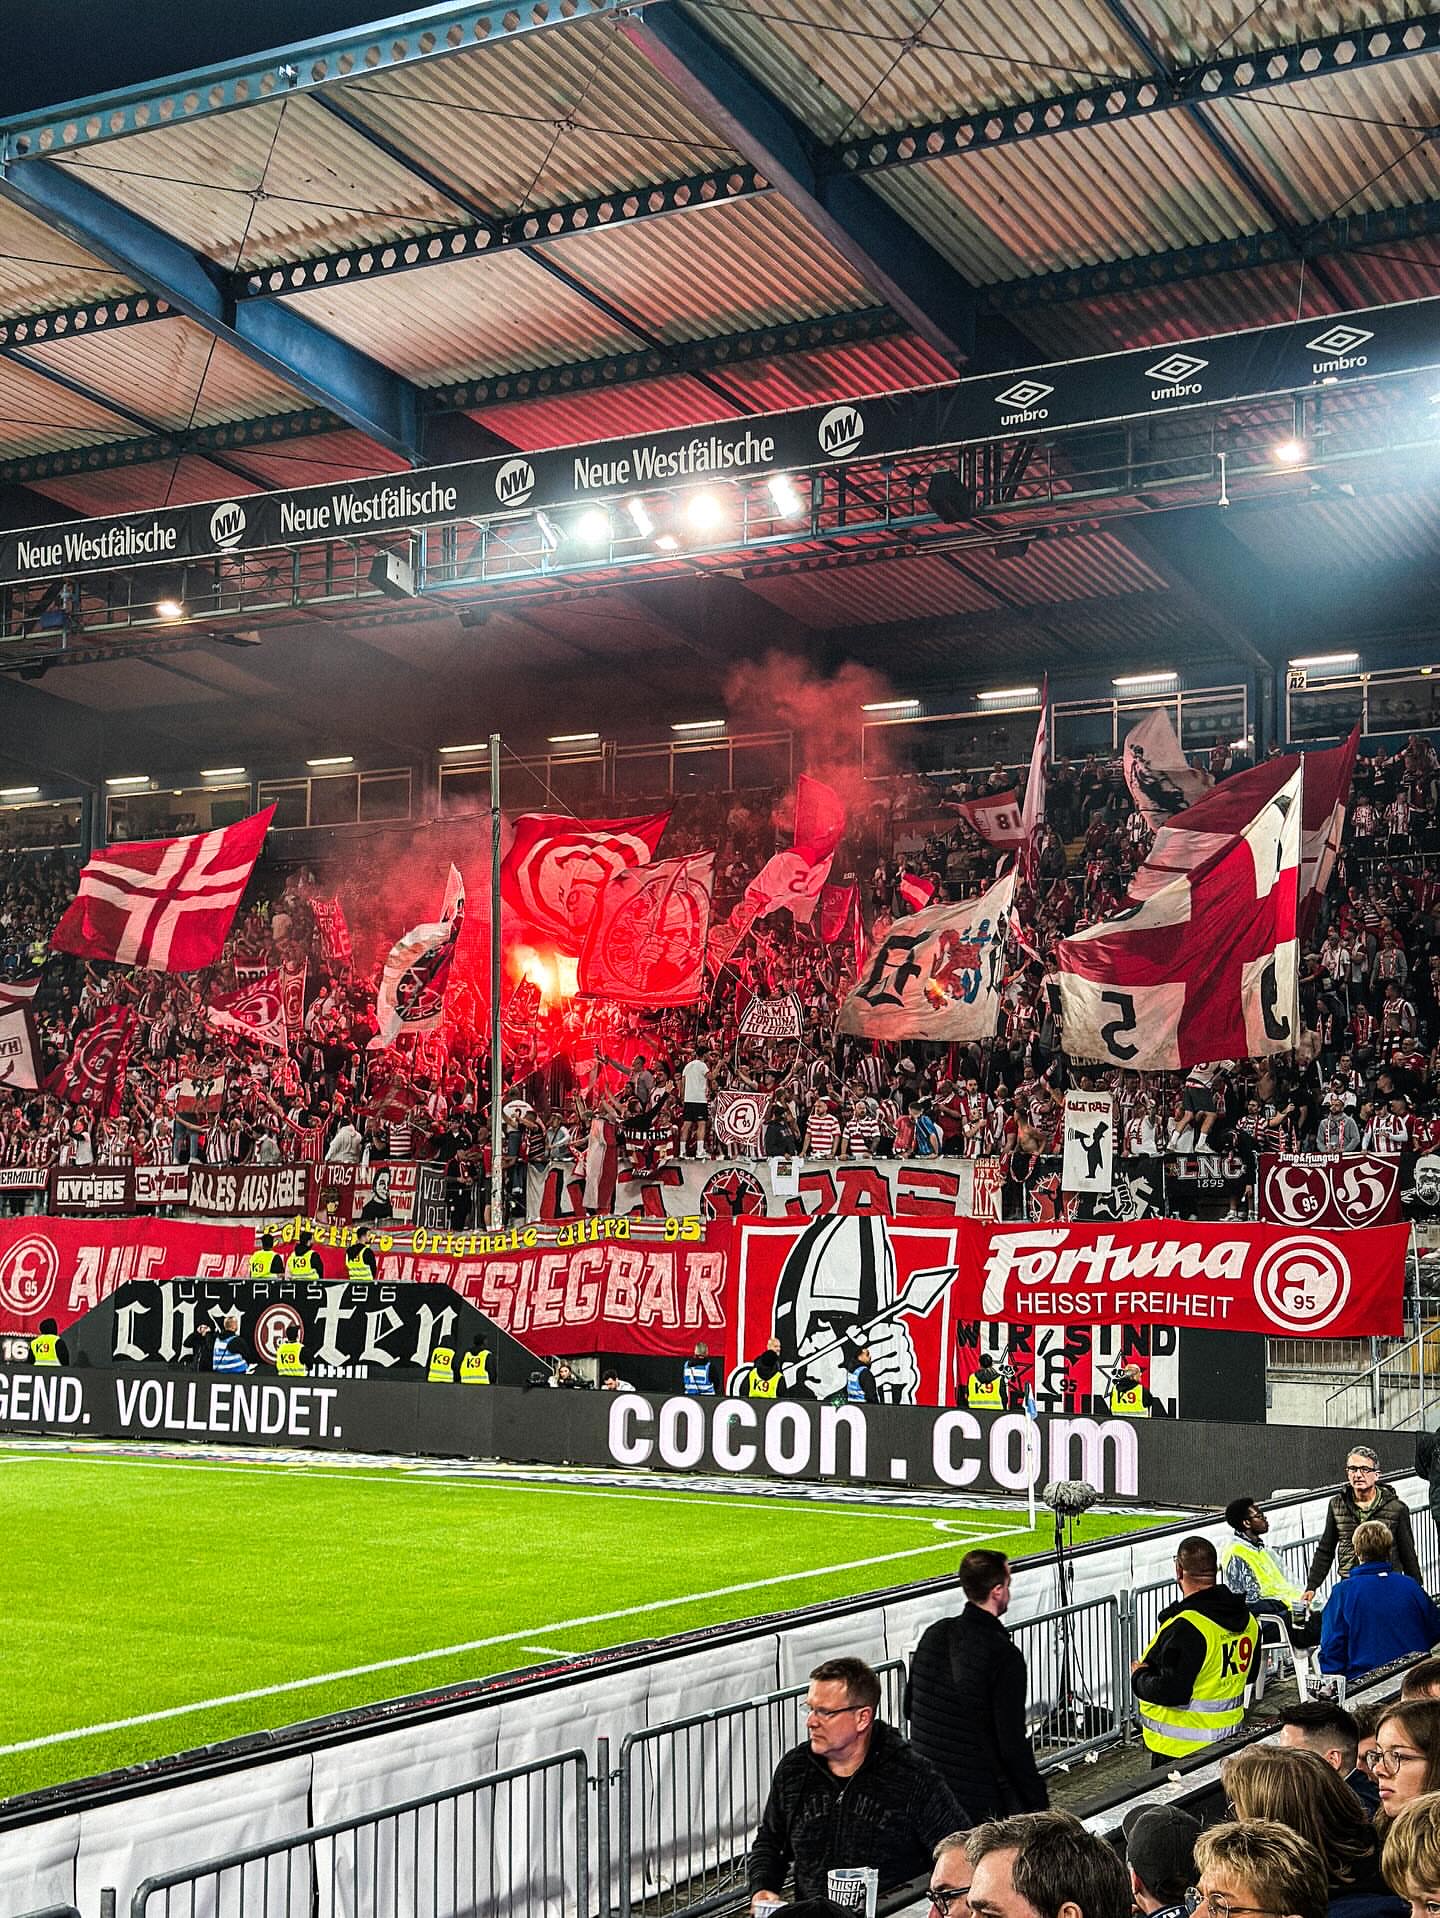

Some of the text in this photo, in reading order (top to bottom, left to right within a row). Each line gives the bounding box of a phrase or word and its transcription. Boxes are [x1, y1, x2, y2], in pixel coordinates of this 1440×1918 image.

[1313, 354, 1368, 374] umbro
[1151, 381, 1203, 401] umbro
[1001, 407, 1049, 426] umbro
[823, 411, 858, 450] NW
[574, 431, 775, 490] Neue Westfälische
[501, 464, 530, 500] NW
[280, 481, 457, 533] Neue Westfälische
[215, 509, 243, 541] NW
[17, 521, 177, 570] Neue Westfälische
[56, 1180, 126, 1201] HYPERS
[188, 1168, 306, 1213] ALLES AUS LIEBE
[1196, 1179, 1225, 1189] 1895
[663, 1215, 702, 1243] 95
[252, 1262, 264, 1273] K9
[292, 1257, 307, 1269] K9
[983, 1228, 1251, 1317] Fortuna
[178, 1281, 324, 1301] ULTRAS
[1016, 1291, 1234, 1319] HEISST FREIHEIT
[35, 1343, 50, 1354] K9
[1063, 1324, 1177, 1357] SIND
[280, 1354, 296, 1364] K9
[433, 1353, 451, 1366] K9
[466, 1357, 481, 1369] K9
[752, 1378, 770, 1393] K9
[974, 1381, 994, 1395] K9
[1116, 1391, 1137, 1404] K9
[116, 1378, 343, 1438] VOLLENDET.
[1220, 1636, 1254, 1678] K9
